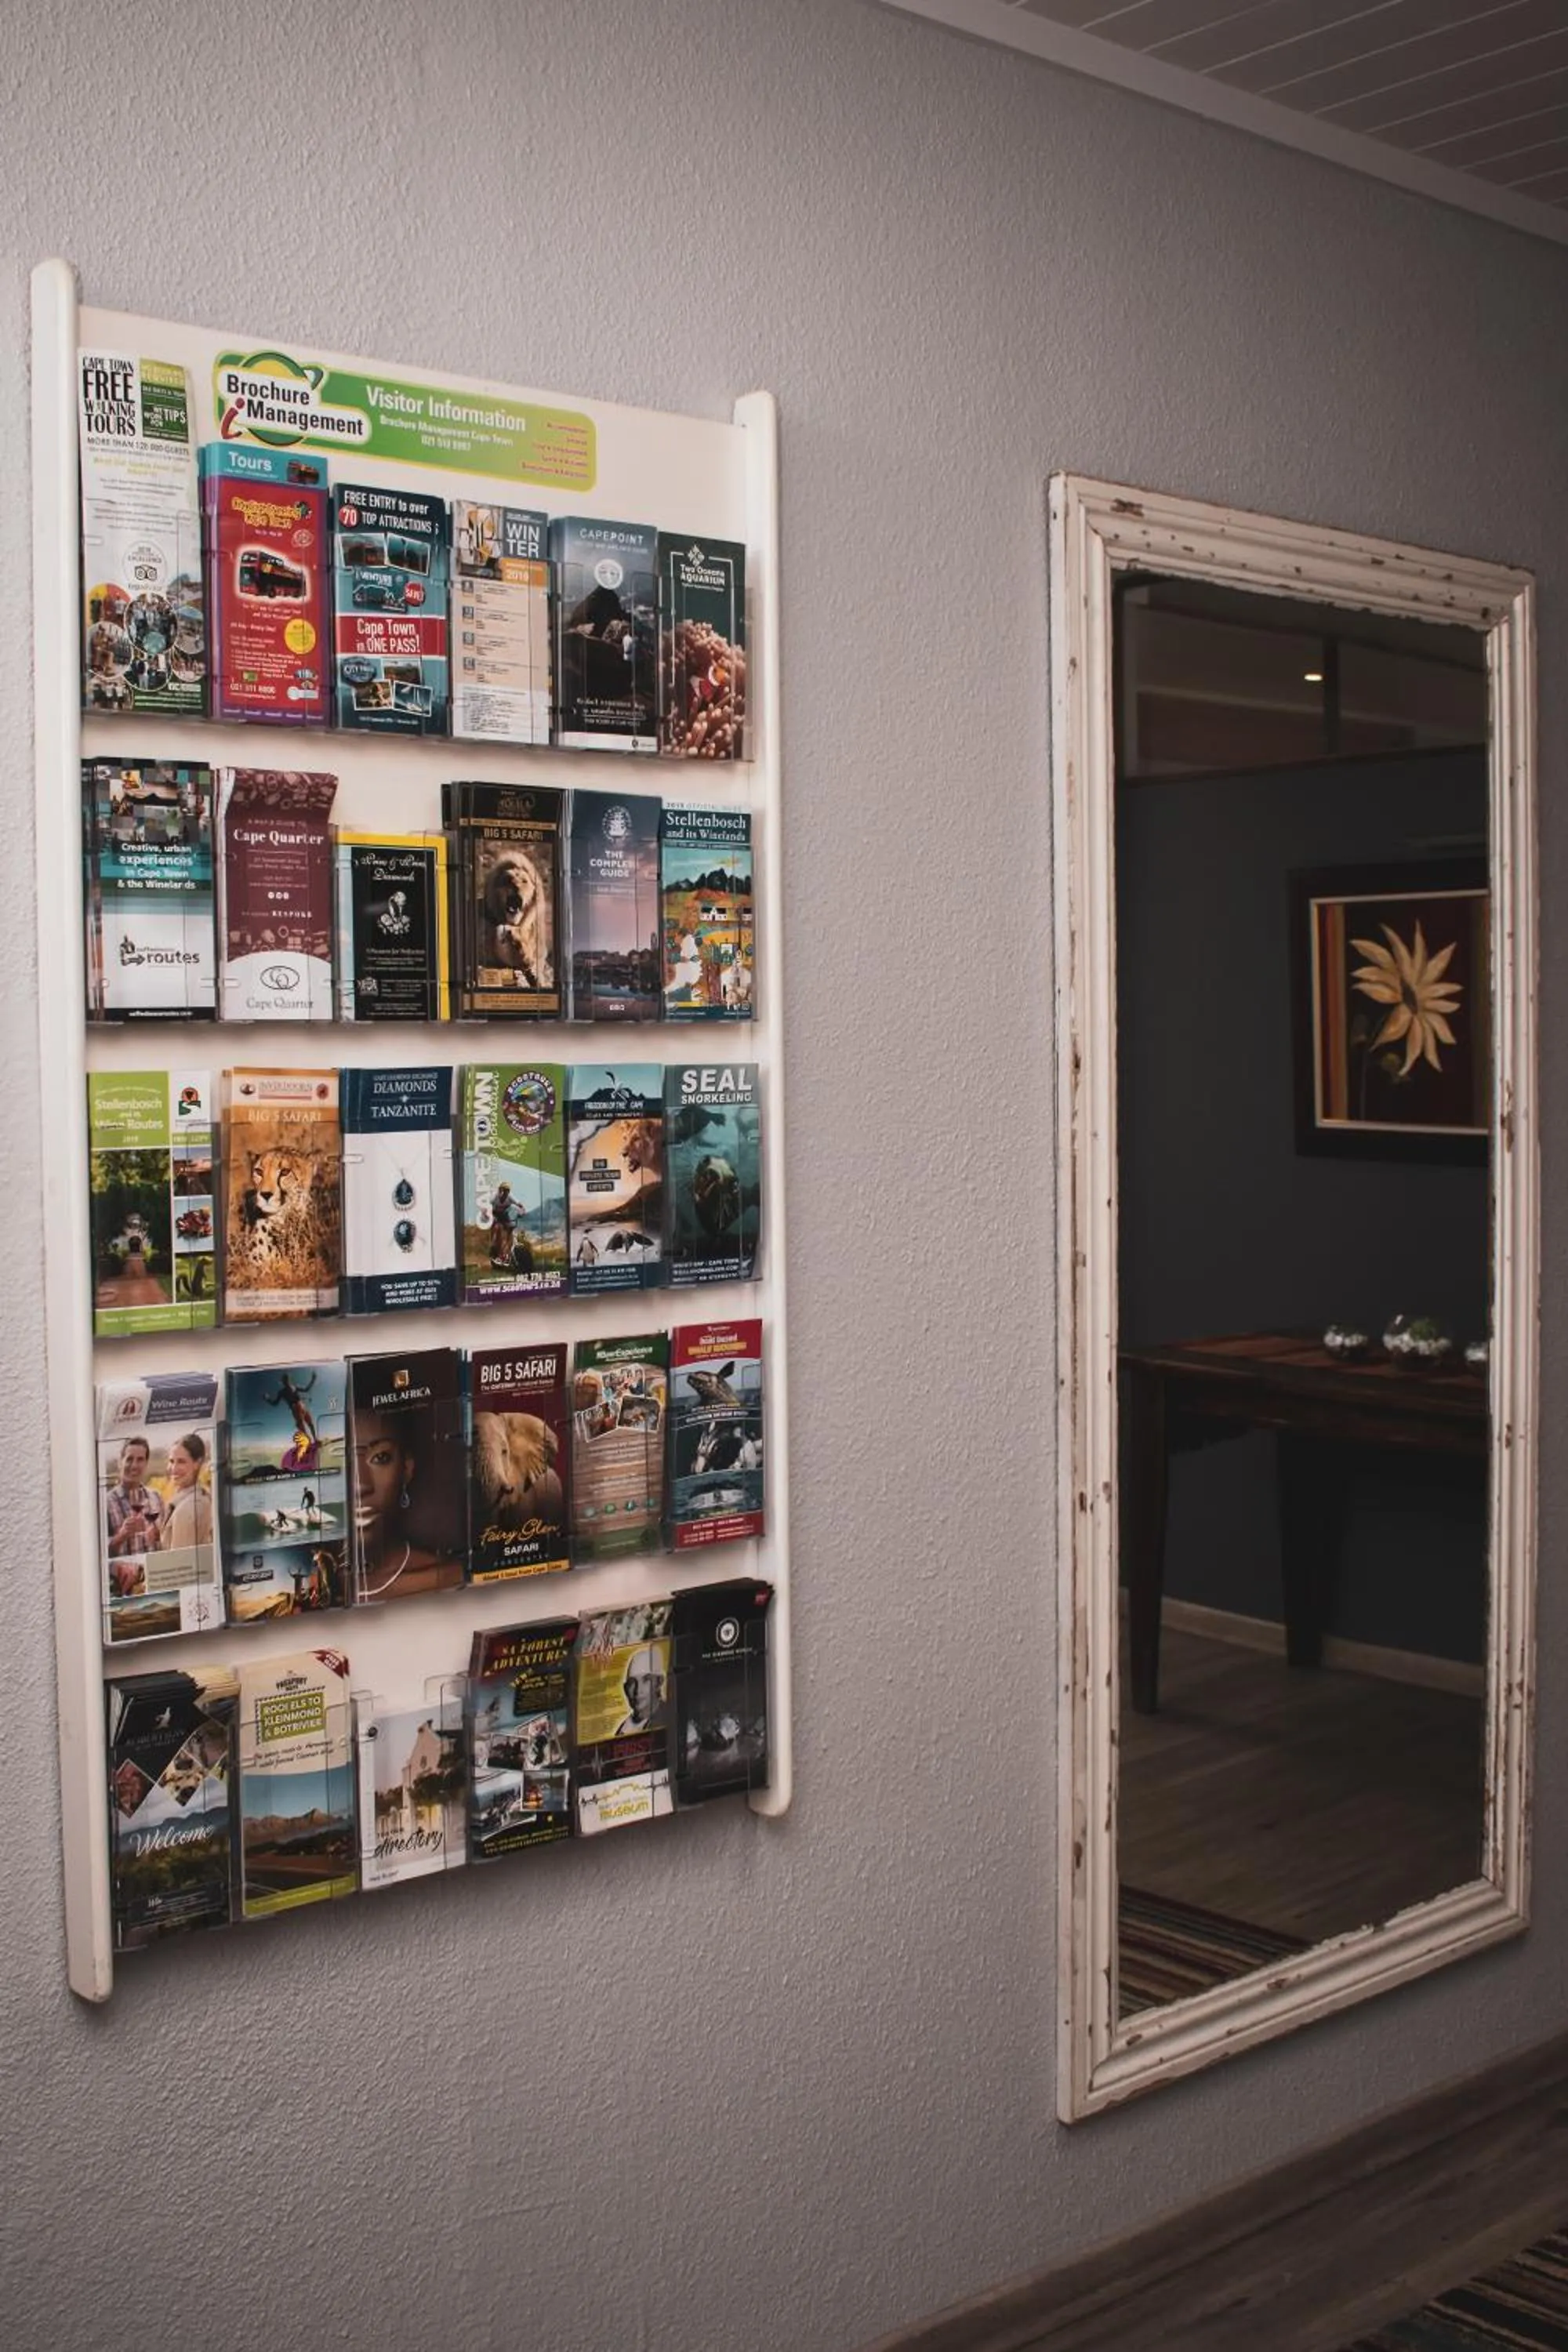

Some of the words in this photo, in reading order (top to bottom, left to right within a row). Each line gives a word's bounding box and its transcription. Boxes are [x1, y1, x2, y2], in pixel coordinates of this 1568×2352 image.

[83, 357, 103, 369] CAPE
[110, 359, 134, 373] TOWN
[83, 369, 135, 403] FREE
[227, 375, 310, 405] Brochure
[163, 409, 185, 423] TIPS
[366, 384, 423, 414] Visitor
[429, 396, 525, 431] Information
[85, 414, 136, 436] TOURS
[247, 399, 363, 435] Management
[380, 416, 416, 430] Brochure
[418, 422, 470, 439] Management
[228, 451, 272, 471] Tours
[345, 491, 368, 506] FREE
[369, 493, 397, 510] ENTRY
[398, 499, 407, 510] to
[409, 503, 429, 515] over
[343, 508, 357, 524] 70
[362, 513, 377, 524] TOP
[379, 514, 431, 533] ATTRACTIONS
[506, 521, 540, 543] WIN
[506, 539, 539, 558] TER
[681, 572, 725, 586] AQUARIUM
[697, 567, 724, 576] Oceans
[357, 619, 383, 639] Cape
[386, 619, 416, 635] Town
[357, 640, 365, 652] in
[367, 637, 388, 652] ONE
[390, 634, 420, 652] PASS!
[666, 812, 746, 829] Stellenbosch
[234, 829, 267, 845] Cape
[269, 830, 324, 846] Quarter
[484, 828, 499, 838] BIG
[666, 829, 684, 838] and
[686, 829, 697, 838] its
[699, 829, 746, 841] Winelands
[119, 855, 194, 866] experiences
[605, 850, 623, 858] THE
[137, 869, 160, 879] Cape
[601, 869, 630, 877] GUIDE
[146, 880, 195, 889] Winelands
[147, 951, 200, 964] routes
[246, 997, 272, 1010] Cape
[373, 1080, 437, 1094] DIAMONDS
[681, 1068, 752, 1094] SEAL
[94, 1098, 162, 1110] Stellenbosch
[681, 1093, 752, 1105] SNORKELING
[249, 1110, 270, 1121] BIG
[283, 1110, 321, 1122] SAFARI
[370, 1104, 437, 1118] TANZANITE
[473, 1072, 493, 1152] TOWN
[128, 1120, 164, 1130] Routes
[474, 1156, 494, 1230] CAPE
[481, 1364, 501, 1383] BIG
[505, 1363, 512, 1380] 5
[515, 1359, 556, 1379] SAFARI
[152, 1400, 178, 1409] Wine
[372, 1393, 397, 1408] JEWEL
[399, 1387, 430, 1399] AFRICA
[479, 1525, 517, 1547] Fairy
[504, 1543, 539, 1555] SAFARI
[291, 1700, 307, 1710] ELS
[310, 1696, 321, 1705] TO
[264, 1708, 321, 1726] KLEINMOND
[129, 1824, 214, 1857] Welcome
[374, 1827, 443, 1859] directory
